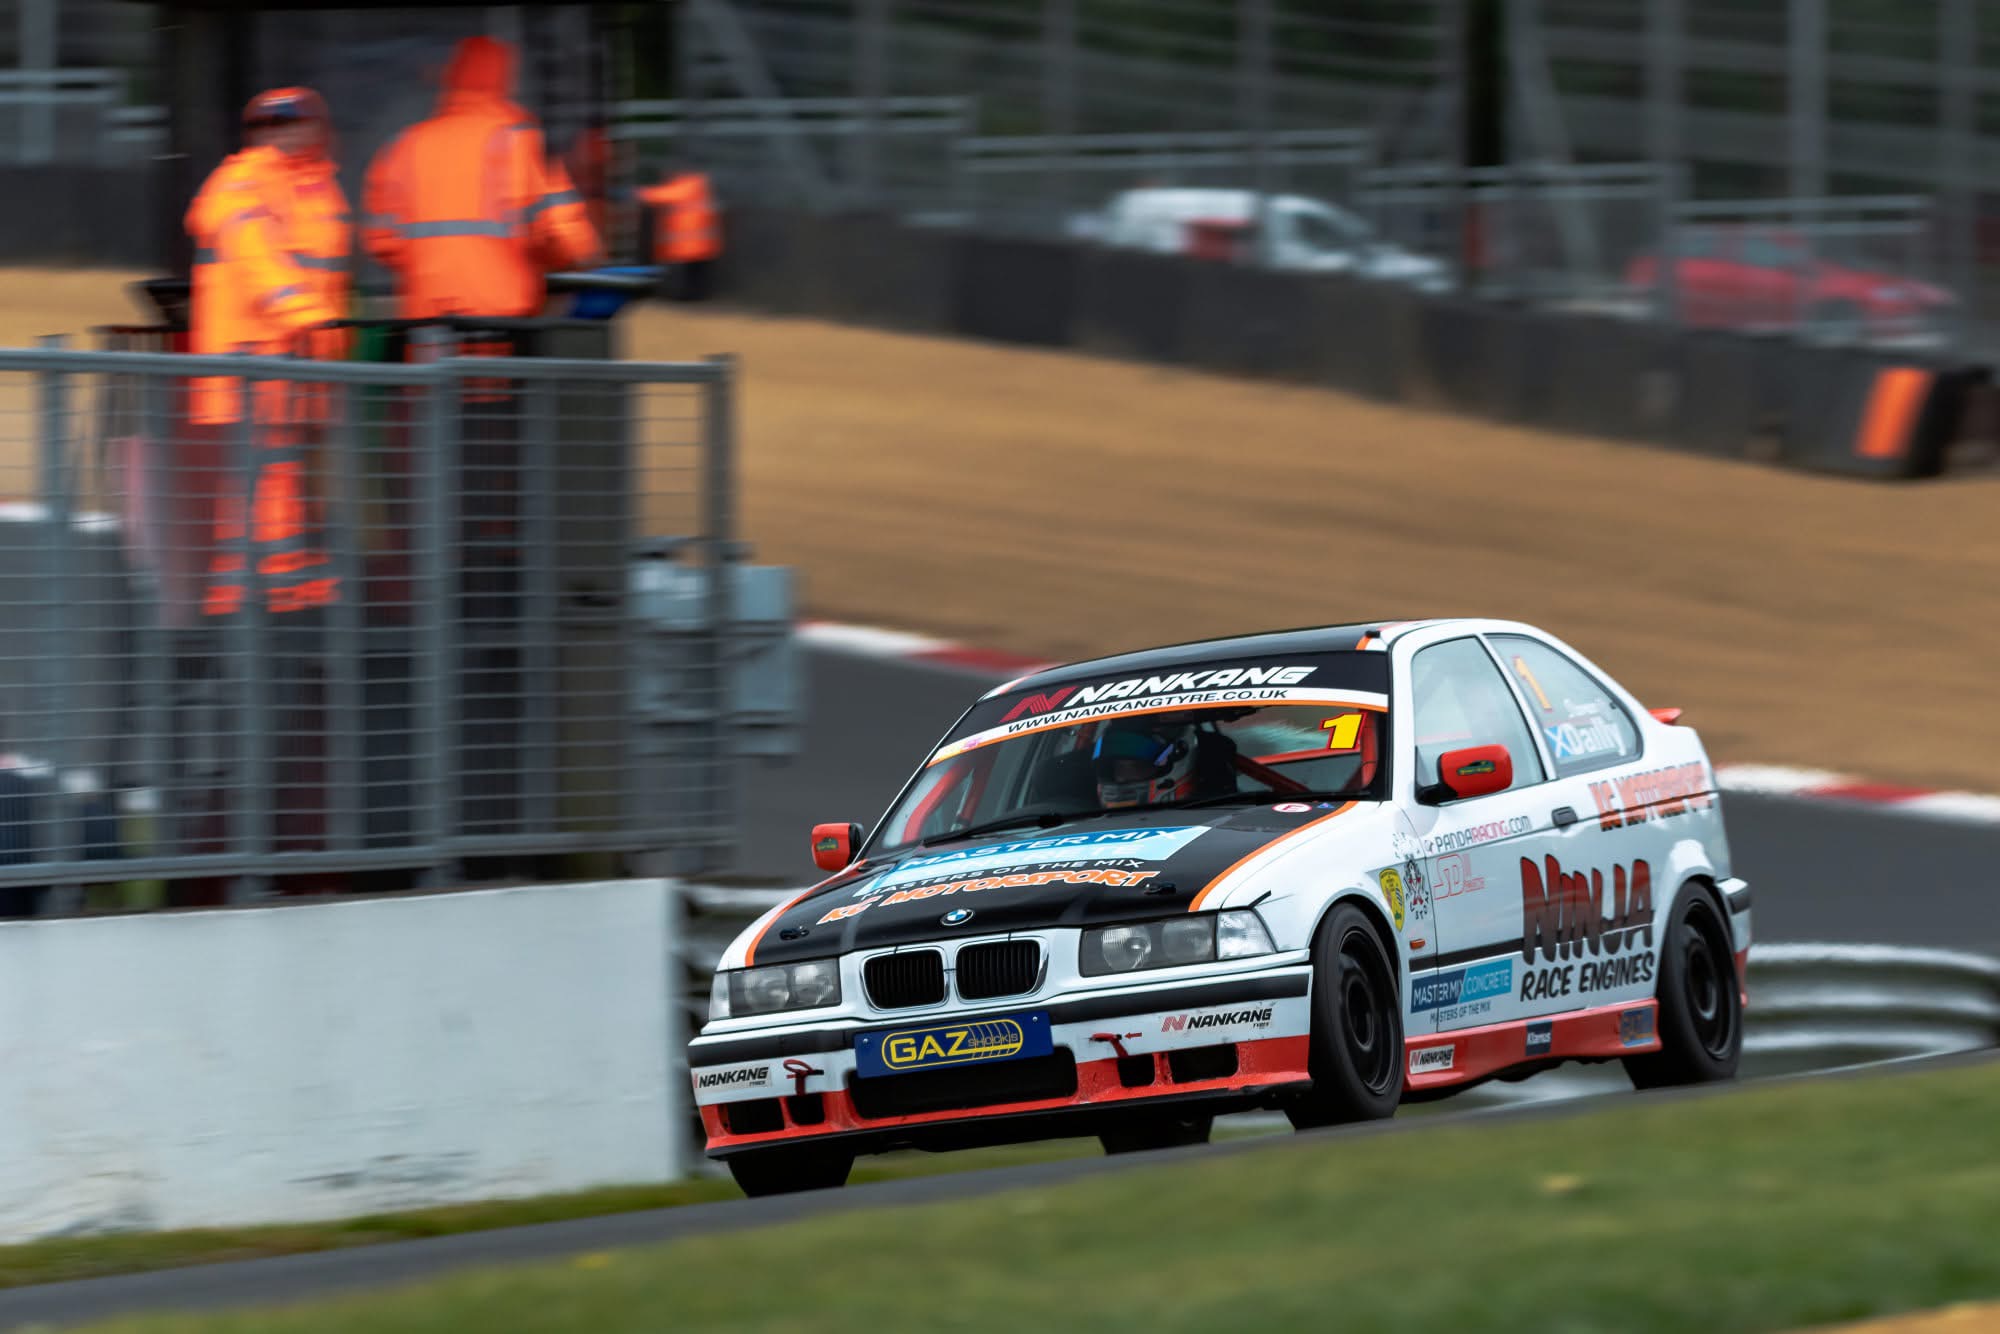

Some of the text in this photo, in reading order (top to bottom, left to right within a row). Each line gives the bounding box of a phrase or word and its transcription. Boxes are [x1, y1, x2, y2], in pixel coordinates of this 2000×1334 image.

[1064, 666, 1318, 707] NANKANG
[1008, 690, 1288, 733] WWW.NANKANGTYRE.CO.UK
[1319, 712, 1367, 750] 1
[899, 830, 1179, 870] MASTER MIX
[860, 858, 1145, 900] MASTERS OF THE MIX
[878, 868, 1161, 907] MOTORSPORT
[1413, 983, 1449, 1007] MASTER
[1465, 969, 1511, 995] CONCRETE
[1520, 952, 1655, 1002] RACE ENGINES
[1187, 1008, 1272, 1029] NANKANG
[1430, 1007, 1458, 1024] MSTERS
[890, 1031, 1019, 1063] GAZ SHOCKS
[699, 1067, 769, 1088] NANKANG
